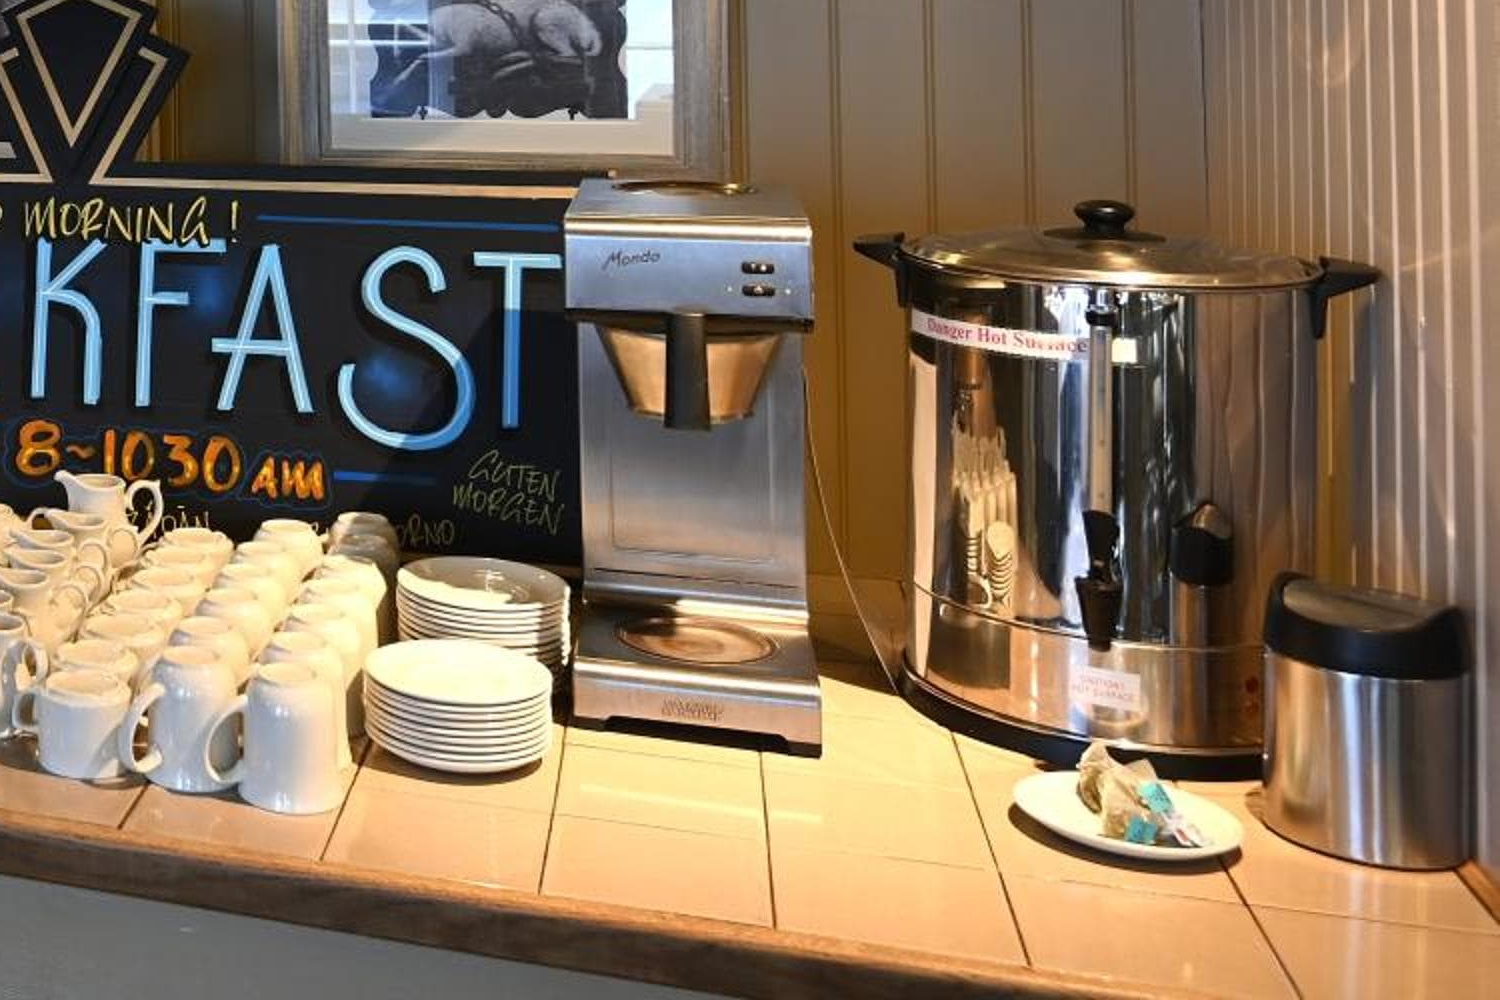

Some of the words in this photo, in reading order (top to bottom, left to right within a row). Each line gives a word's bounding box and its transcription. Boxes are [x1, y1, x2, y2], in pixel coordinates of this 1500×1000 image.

[24, 195, 209, 244] MORNING
[603, 250, 661, 270] Mondo
[927, 317, 973, 341] Danger
[978, 326, 1007, 344] Hot
[468, 449, 561, 502] GUTEN
[453, 482, 565, 536] MORGEN
